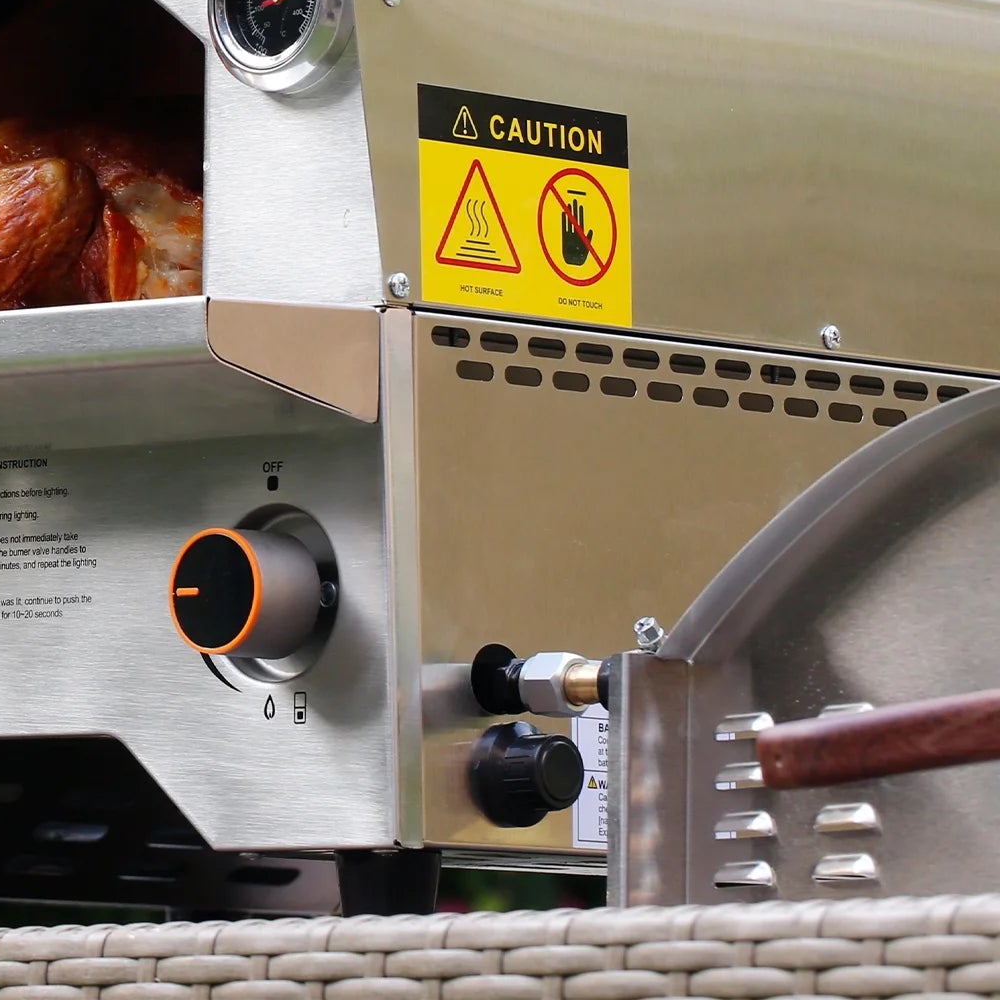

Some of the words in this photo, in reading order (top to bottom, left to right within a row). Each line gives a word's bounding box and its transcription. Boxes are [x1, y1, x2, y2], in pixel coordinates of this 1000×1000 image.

[292, 8, 303, 16] 400
[489, 114, 603, 155] CAUTION
[460, 284, 473, 293] HOT
[474, 287, 504, 297] SURFACE
[558, 297, 567, 305] DO
[568, 298, 582, 307] NOT
[582, 300, 603, 310] TOUCH
[262, 461, 284, 473] OFF
[21, 488, 43, 498] before
[10, 535, 21, 544] not
[22, 532, 63, 544] immediately
[63, 532, 79, 542] take
[9, 547, 31, 557] burner
[32, 546, 50, 556] valve
[51, 545, 79, 555] handles
[79, 544, 87, 554] to
[23, 560, 36, 570] and
[37, 559, 59, 571] repeat
[60, 558, 72, 568] the
[72, 557, 98, 569] lighting
[0, 598, 15, 607] was
[24, 595, 53, 606] continue
[54, 596, 62, 605] to
[62, 594, 80, 605] push
[80, 594, 93, 604] the
[1, 610, 11, 620] for
